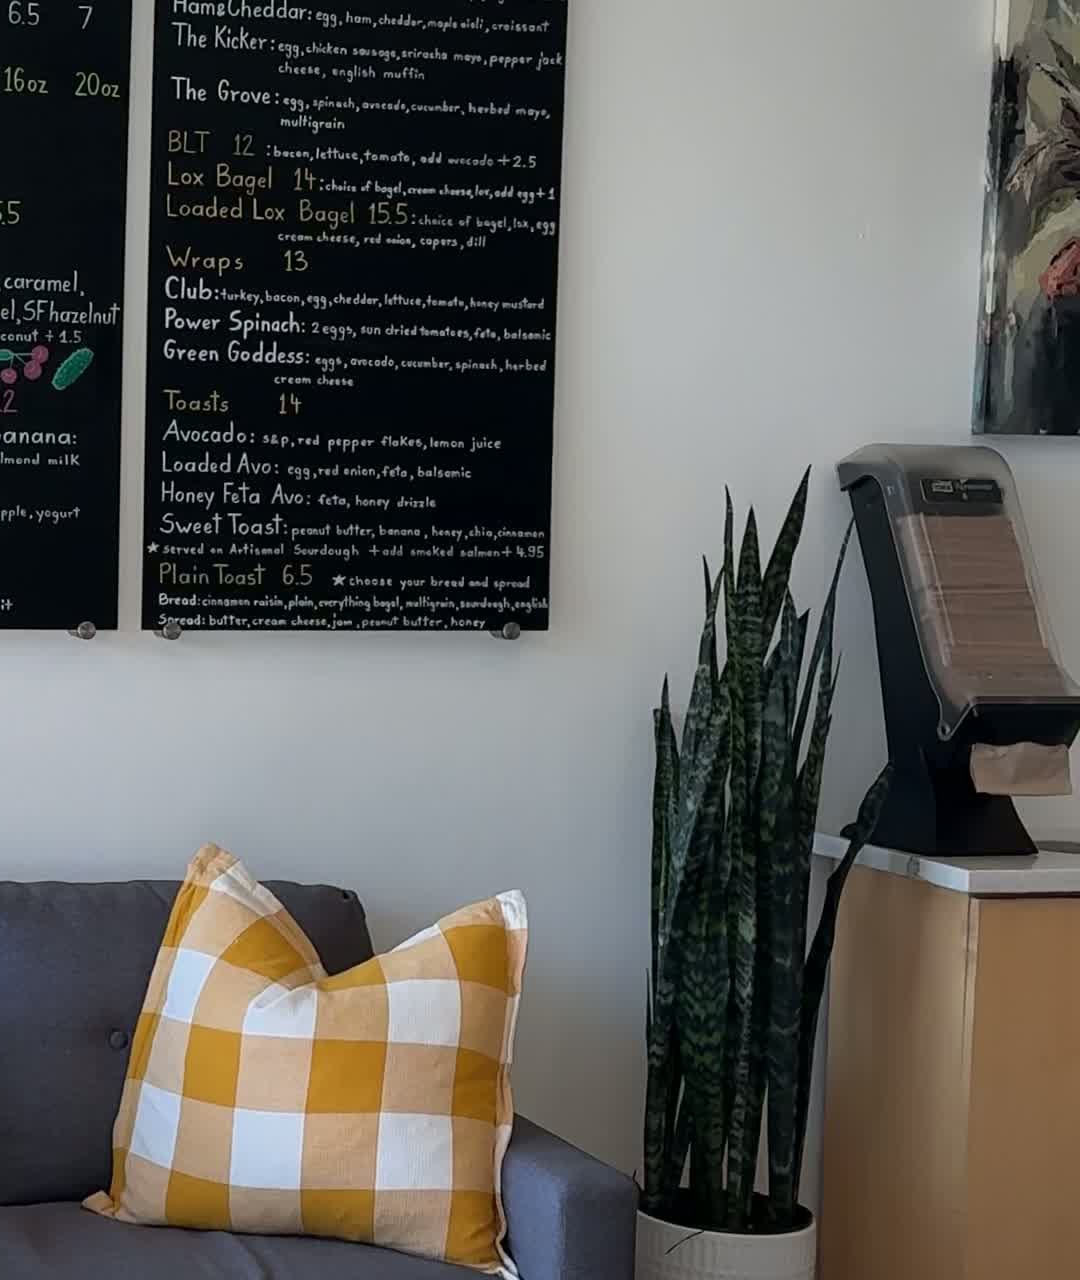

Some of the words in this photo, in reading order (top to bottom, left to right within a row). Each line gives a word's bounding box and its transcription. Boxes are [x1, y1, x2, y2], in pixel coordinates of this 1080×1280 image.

[9, 0, 39, 25] 6.5
[78, 6, 93, 29] 7
[280, 115, 345, 134] multigrain
[168, 130, 210, 153] BLT
[234, 134, 255, 156] 12
[168, 160, 204, 186] Lox
[217, 163, 272, 195] Bagel
[167, 193, 242, 218] Loaded
[253, 198, 285, 220] Lox
[300, 199, 354, 230] Bagel
[166, 245, 243, 277] Wraps
[284, 250, 308, 271] 13
[163, 389, 228, 412] Toasts
[161, 480, 215, 510] Honey
[224, 482, 260, 504] Feta
[271, 483, 311, 504] Avo:
[160, 562, 209, 584] Plain
[213, 563, 266, 585] Toast
[283, 564, 312, 585] 6.5
